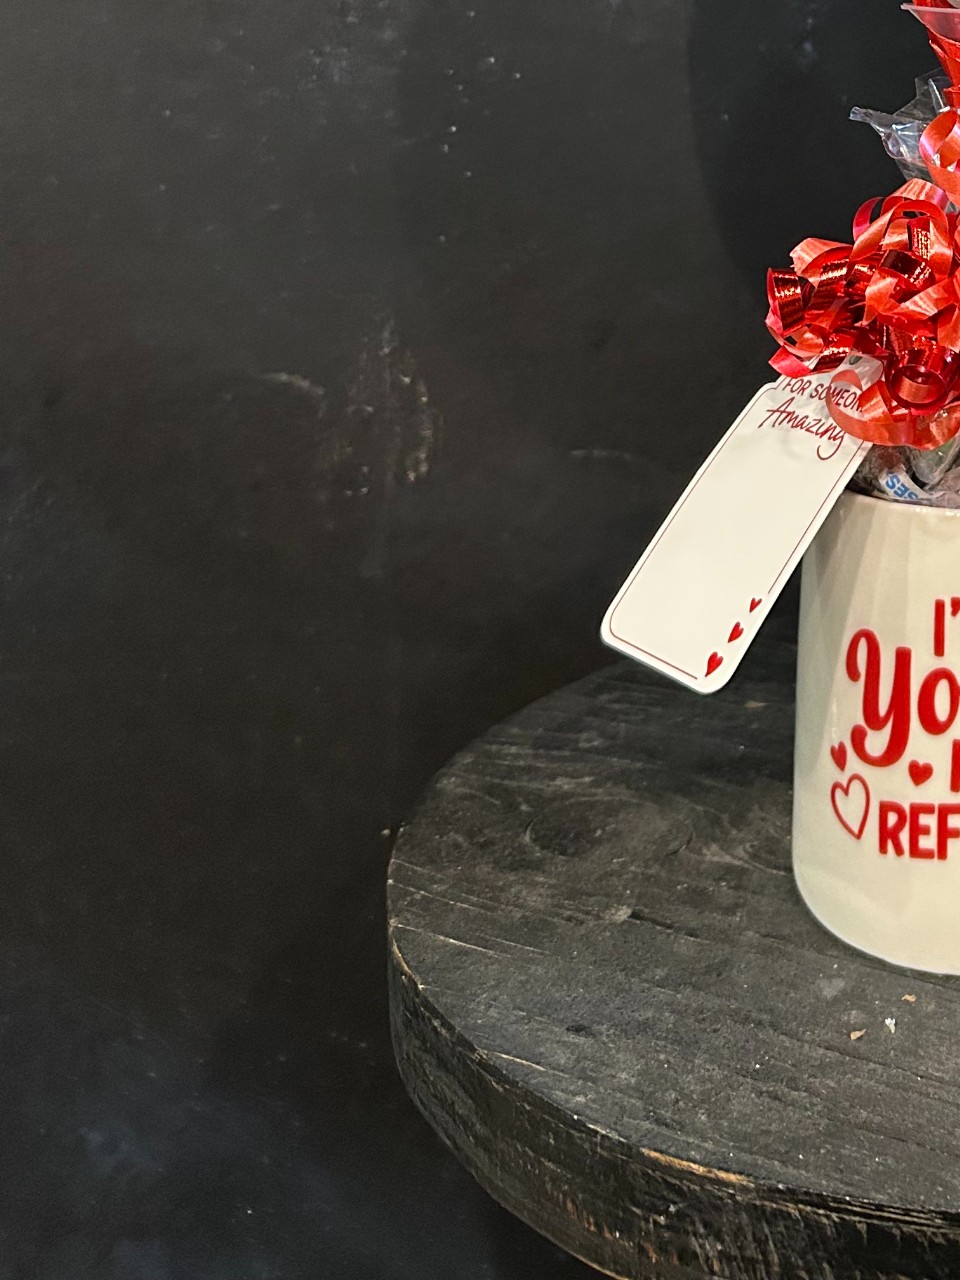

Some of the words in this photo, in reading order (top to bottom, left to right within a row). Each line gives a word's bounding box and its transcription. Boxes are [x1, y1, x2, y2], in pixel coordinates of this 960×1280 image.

[782, 378, 813, 397] FOR
[809, 382, 863, 413] SOMEON
[758, 396, 847, 461] Amazing
